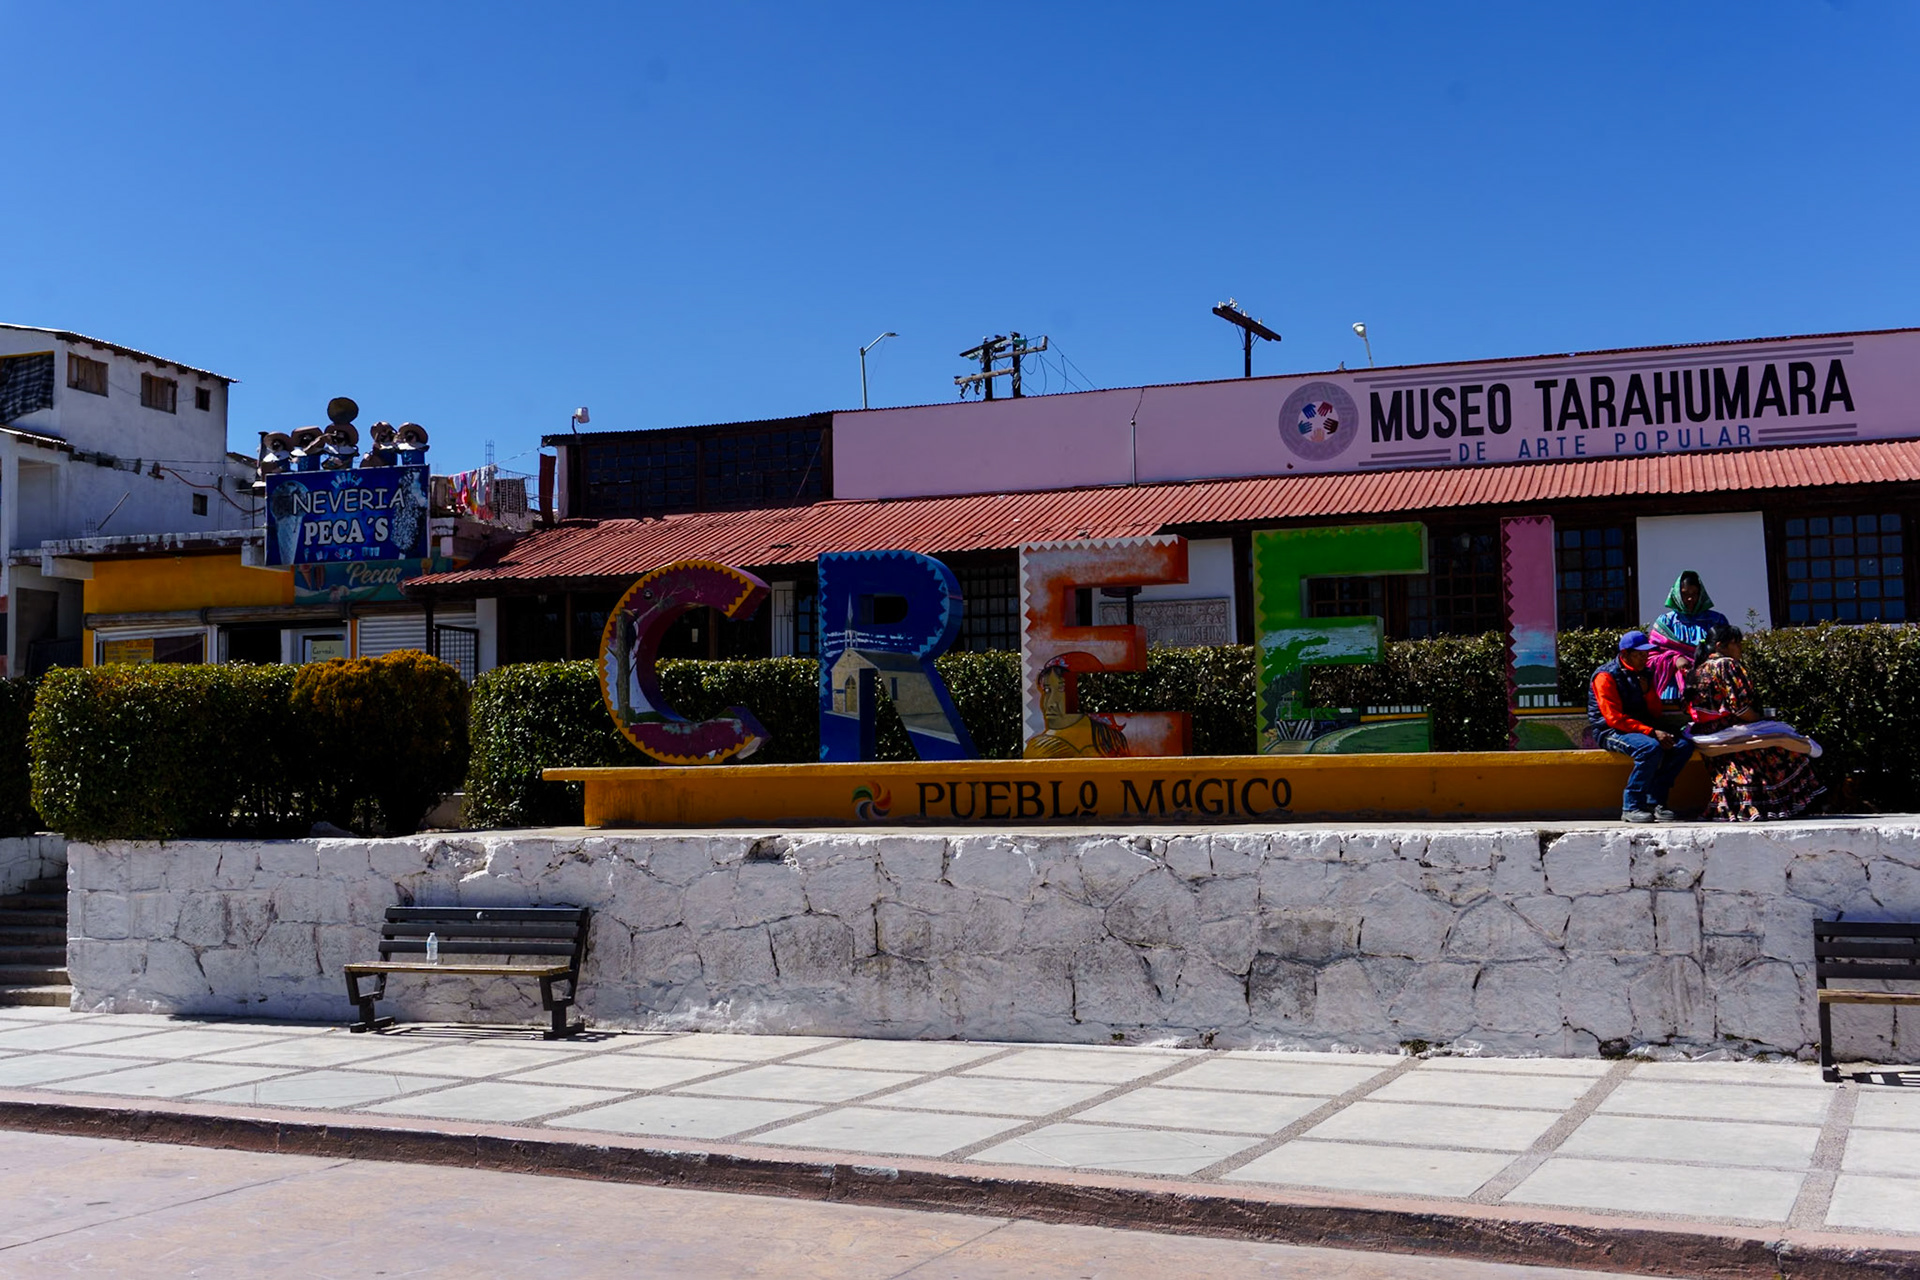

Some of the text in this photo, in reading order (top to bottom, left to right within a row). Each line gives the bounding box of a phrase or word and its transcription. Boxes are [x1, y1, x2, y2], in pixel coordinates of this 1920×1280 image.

[1369, 358, 1854, 442] MUSEO TARAHUMARA
[1458, 424, 1752, 462] DE ARTE POPULAR
[292, 486, 406, 516] NEVERIA
[345, 560, 403, 587] Pecas
[1175, 625, 1226, 642] MUSEUM
